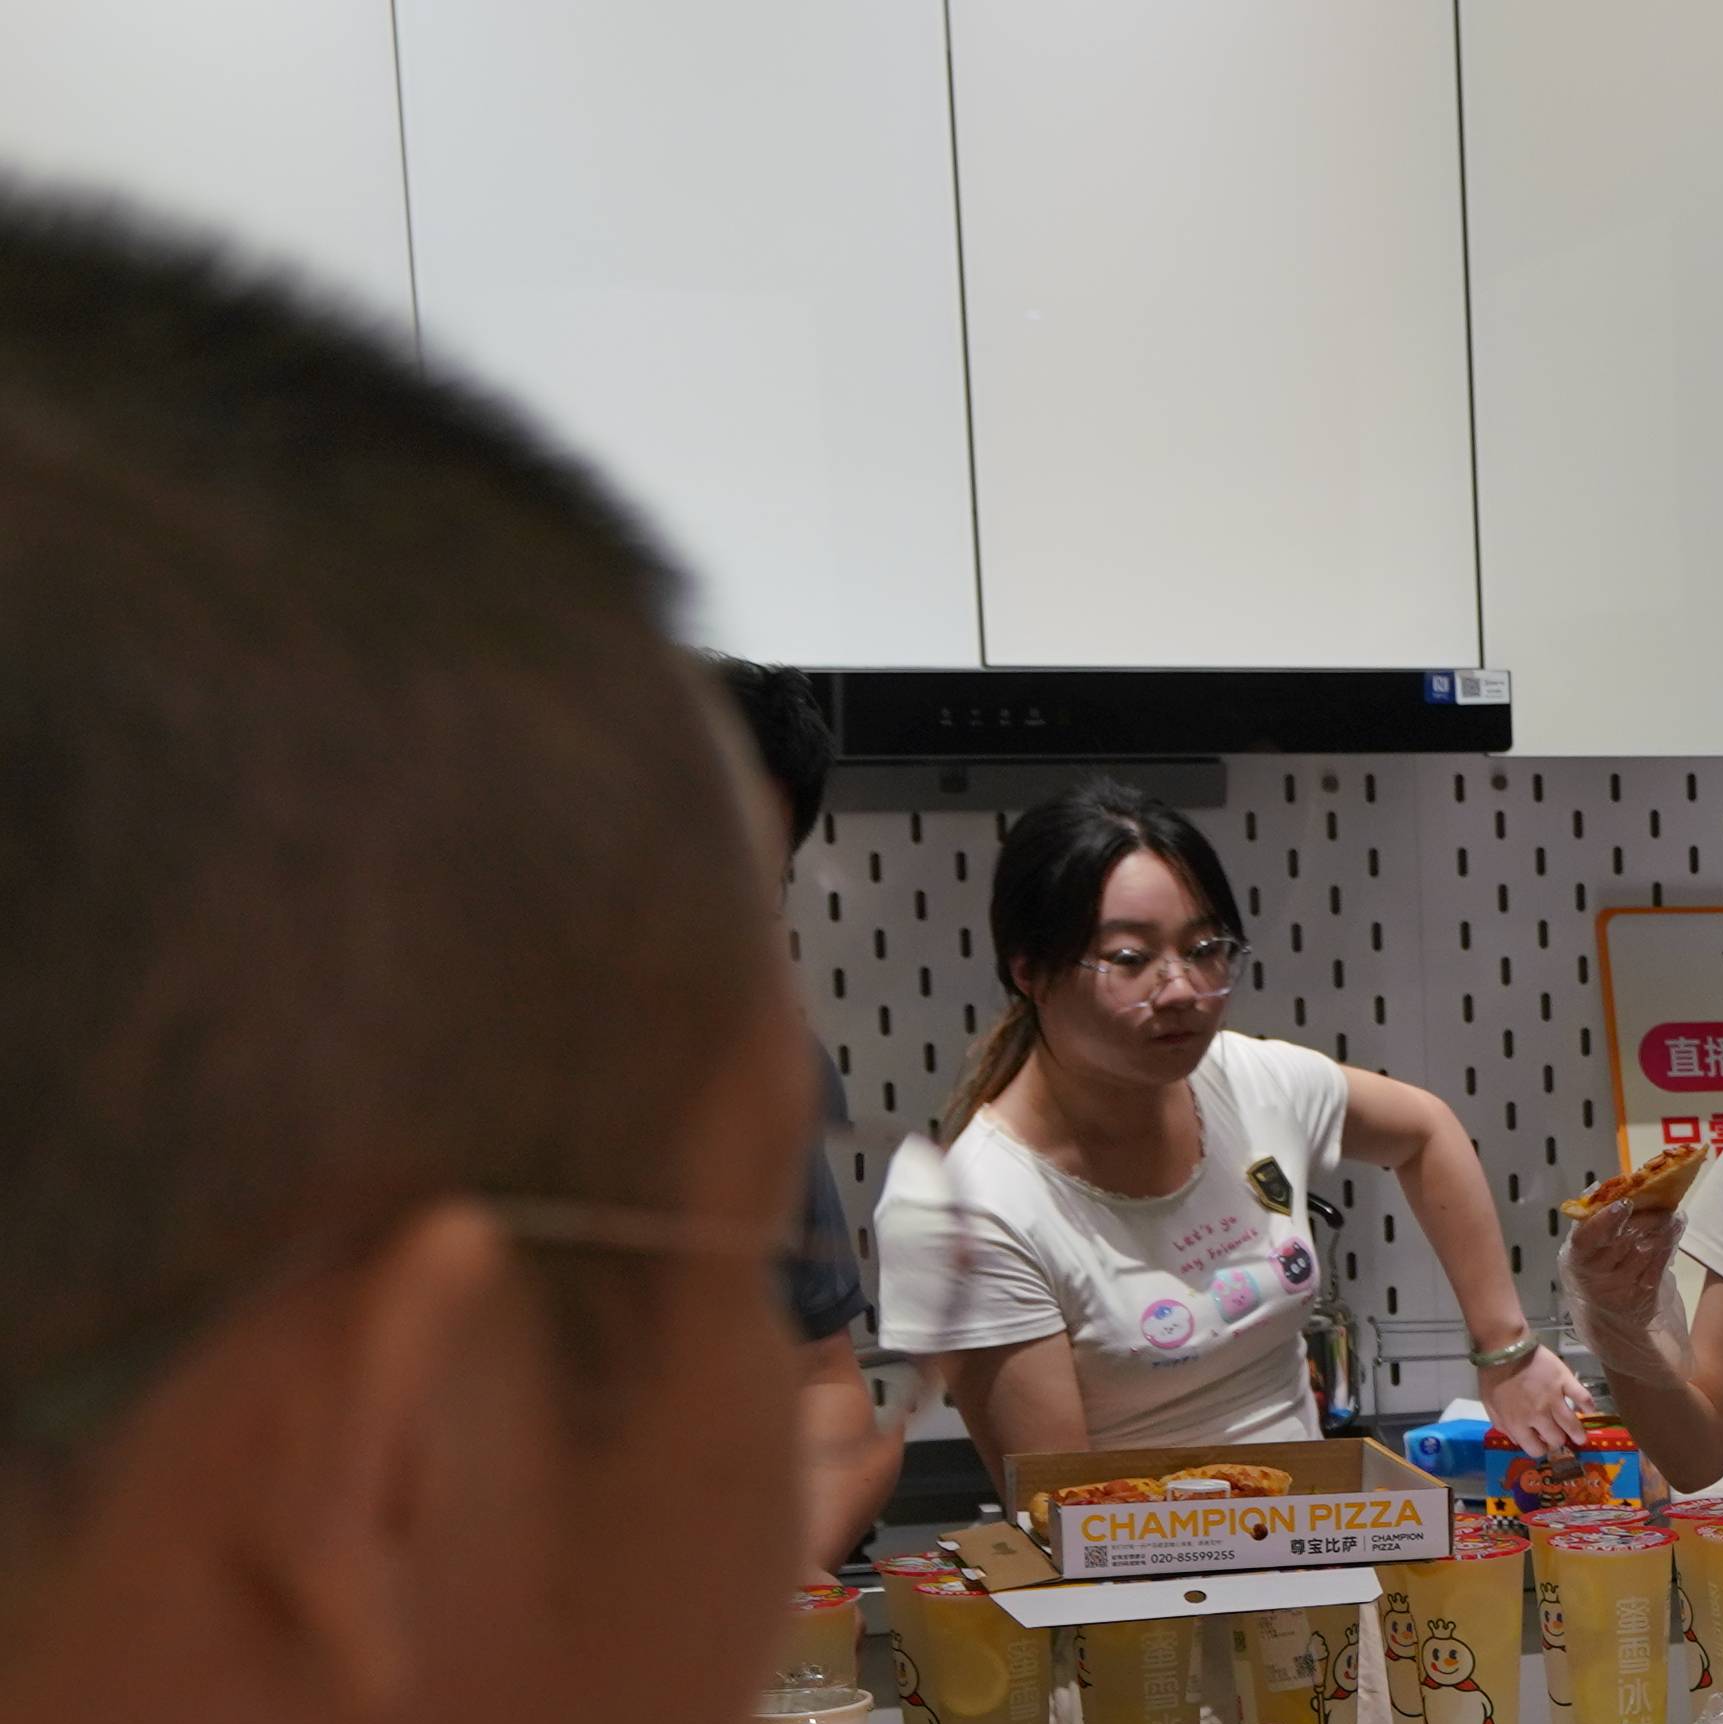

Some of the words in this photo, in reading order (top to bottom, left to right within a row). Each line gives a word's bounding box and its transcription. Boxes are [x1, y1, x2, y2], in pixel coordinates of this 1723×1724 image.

[1080, 1504, 1297, 1543] CHAMPION
[1309, 1498, 1424, 1532] PIZZA
[1371, 1532, 1424, 1543] CHAMPION
[1290, 1536, 1358, 1556] 尊宝比萨
[1371, 1543, 1401, 1551] PIZZA
[1150, 1550, 1236, 1564] 020-85599255
